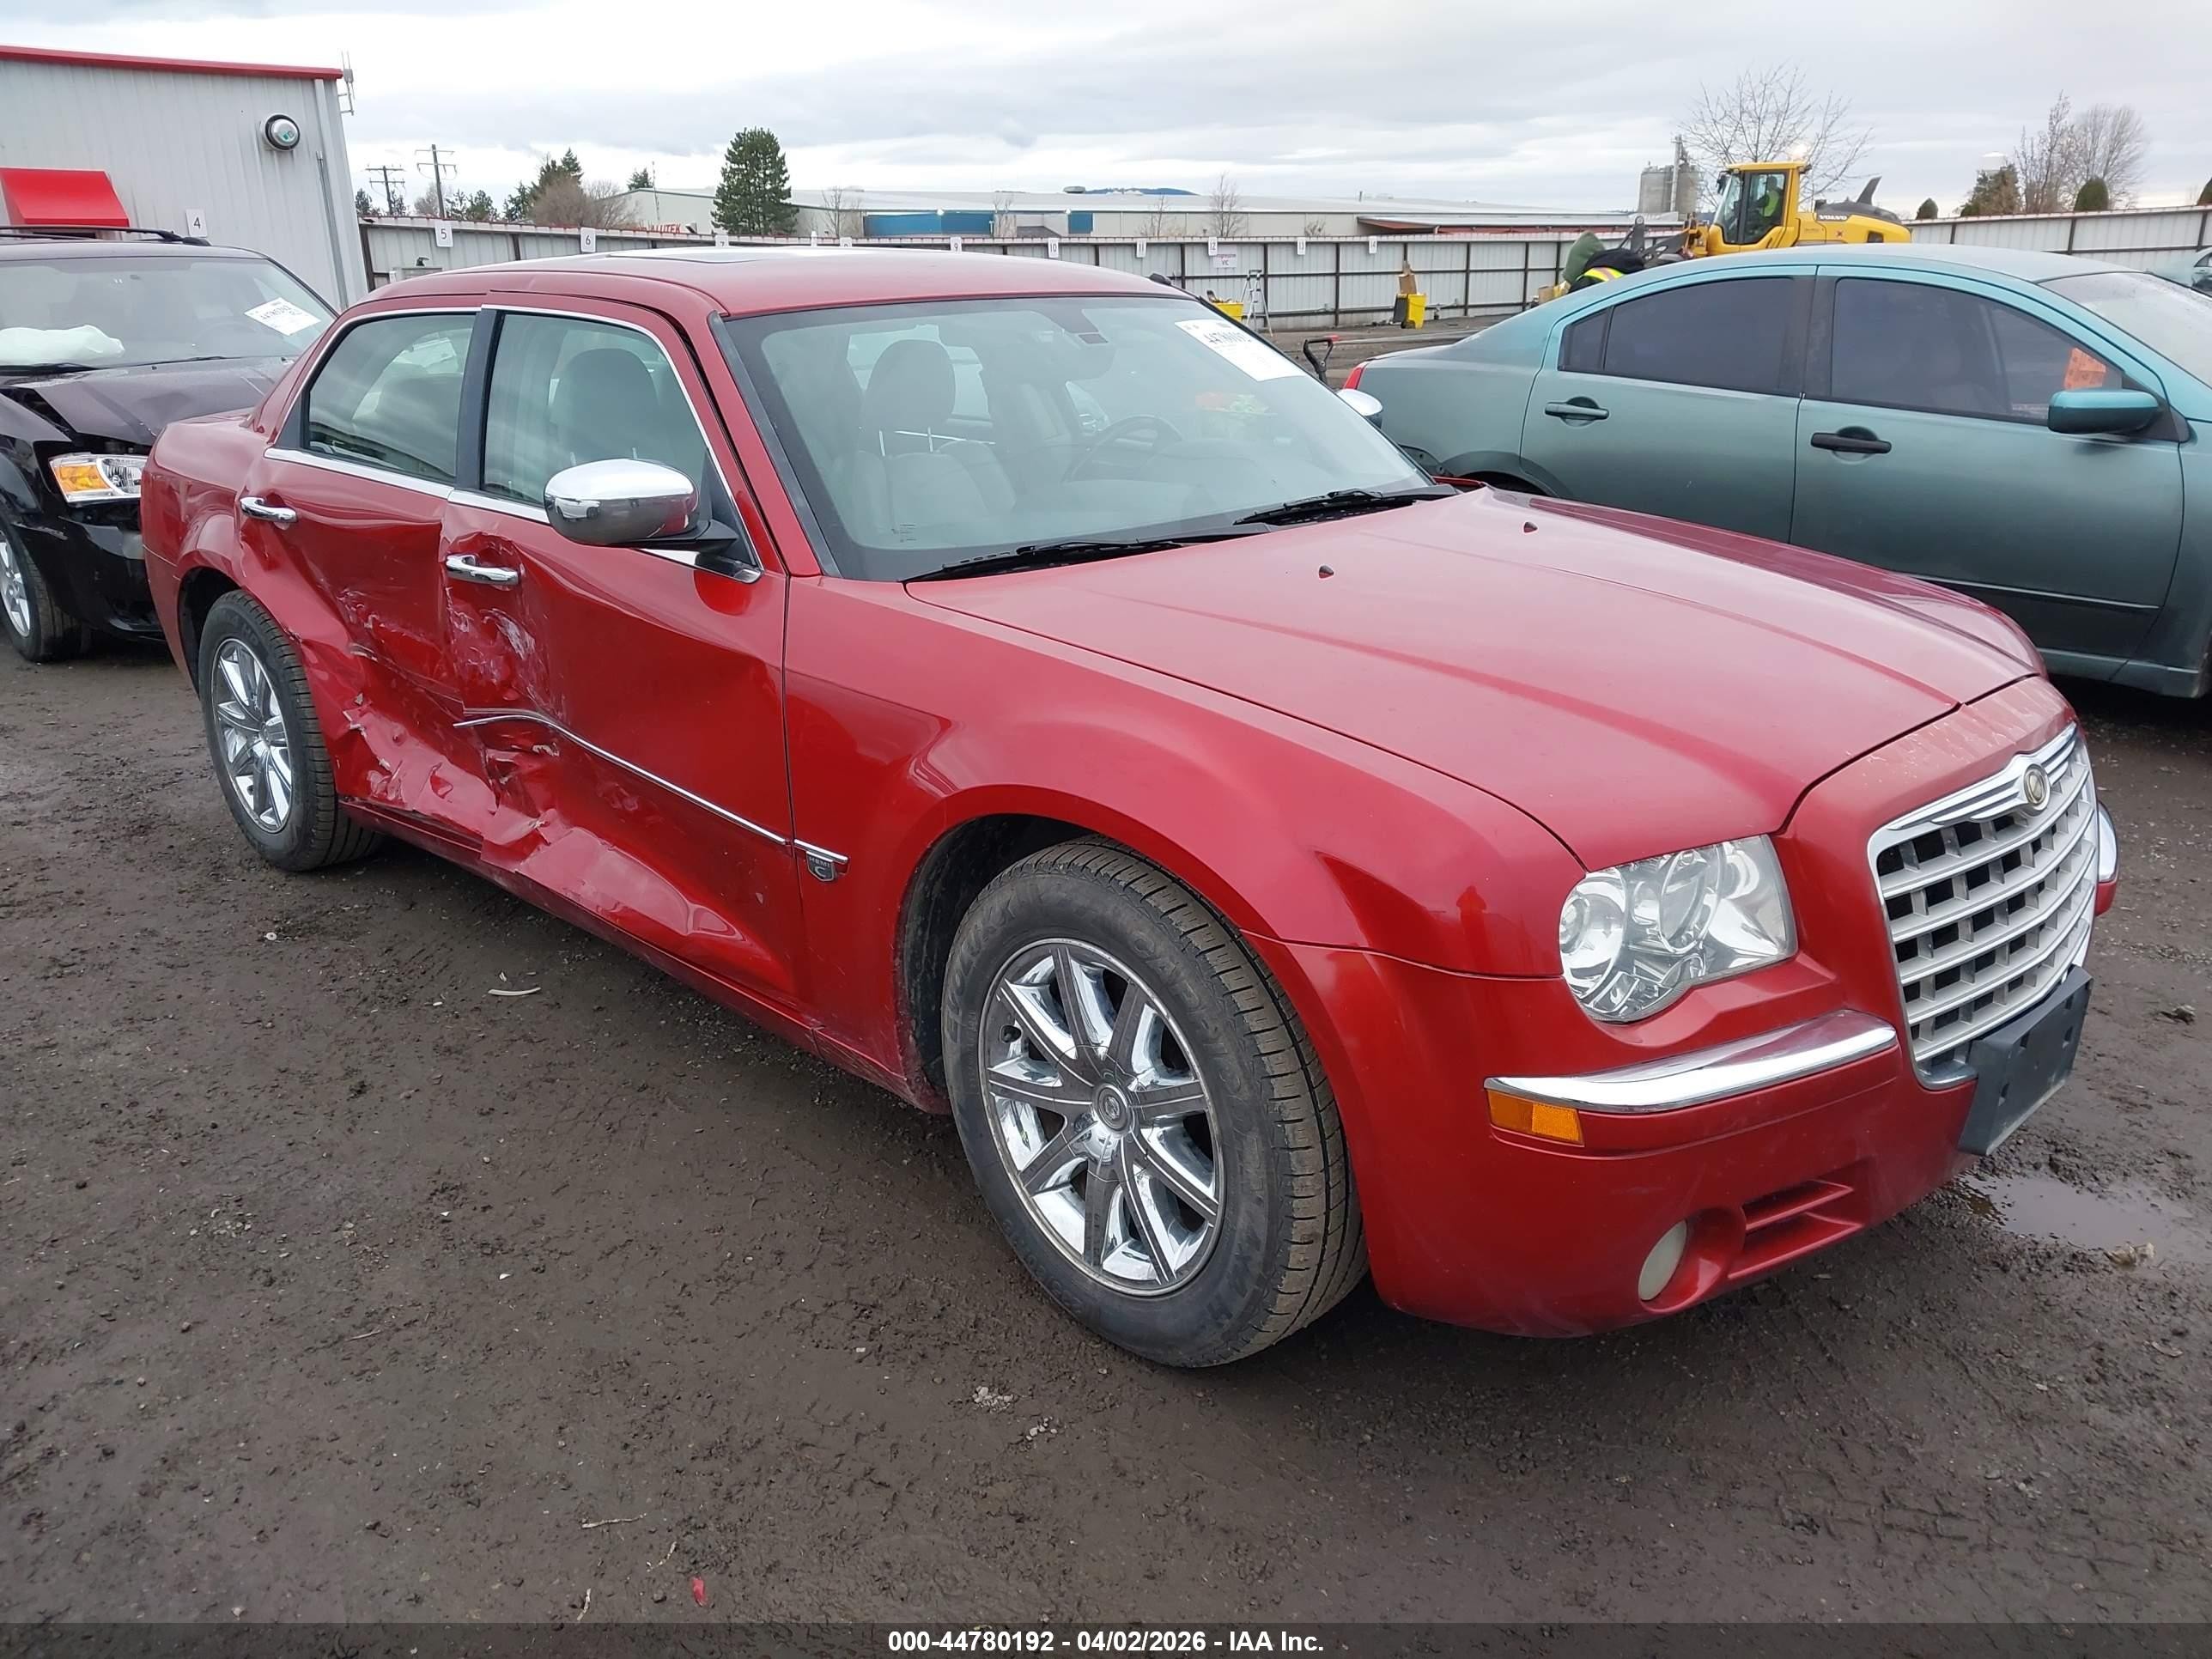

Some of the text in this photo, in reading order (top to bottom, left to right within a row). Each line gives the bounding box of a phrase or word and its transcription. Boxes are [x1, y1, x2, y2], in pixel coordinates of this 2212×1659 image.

[193, 216, 201, 229] 4
[441, 228, 447, 240] 5
[585, 234, 591, 246] 6
[953, 242, 958, 252] 9
[1049, 243, 1057, 252] 10
[1138, 241, 1145, 252] 11
[1209, 241, 1216, 251] 12
[808, 857, 831, 867] HEMI
[814, 866, 826, 878] C
